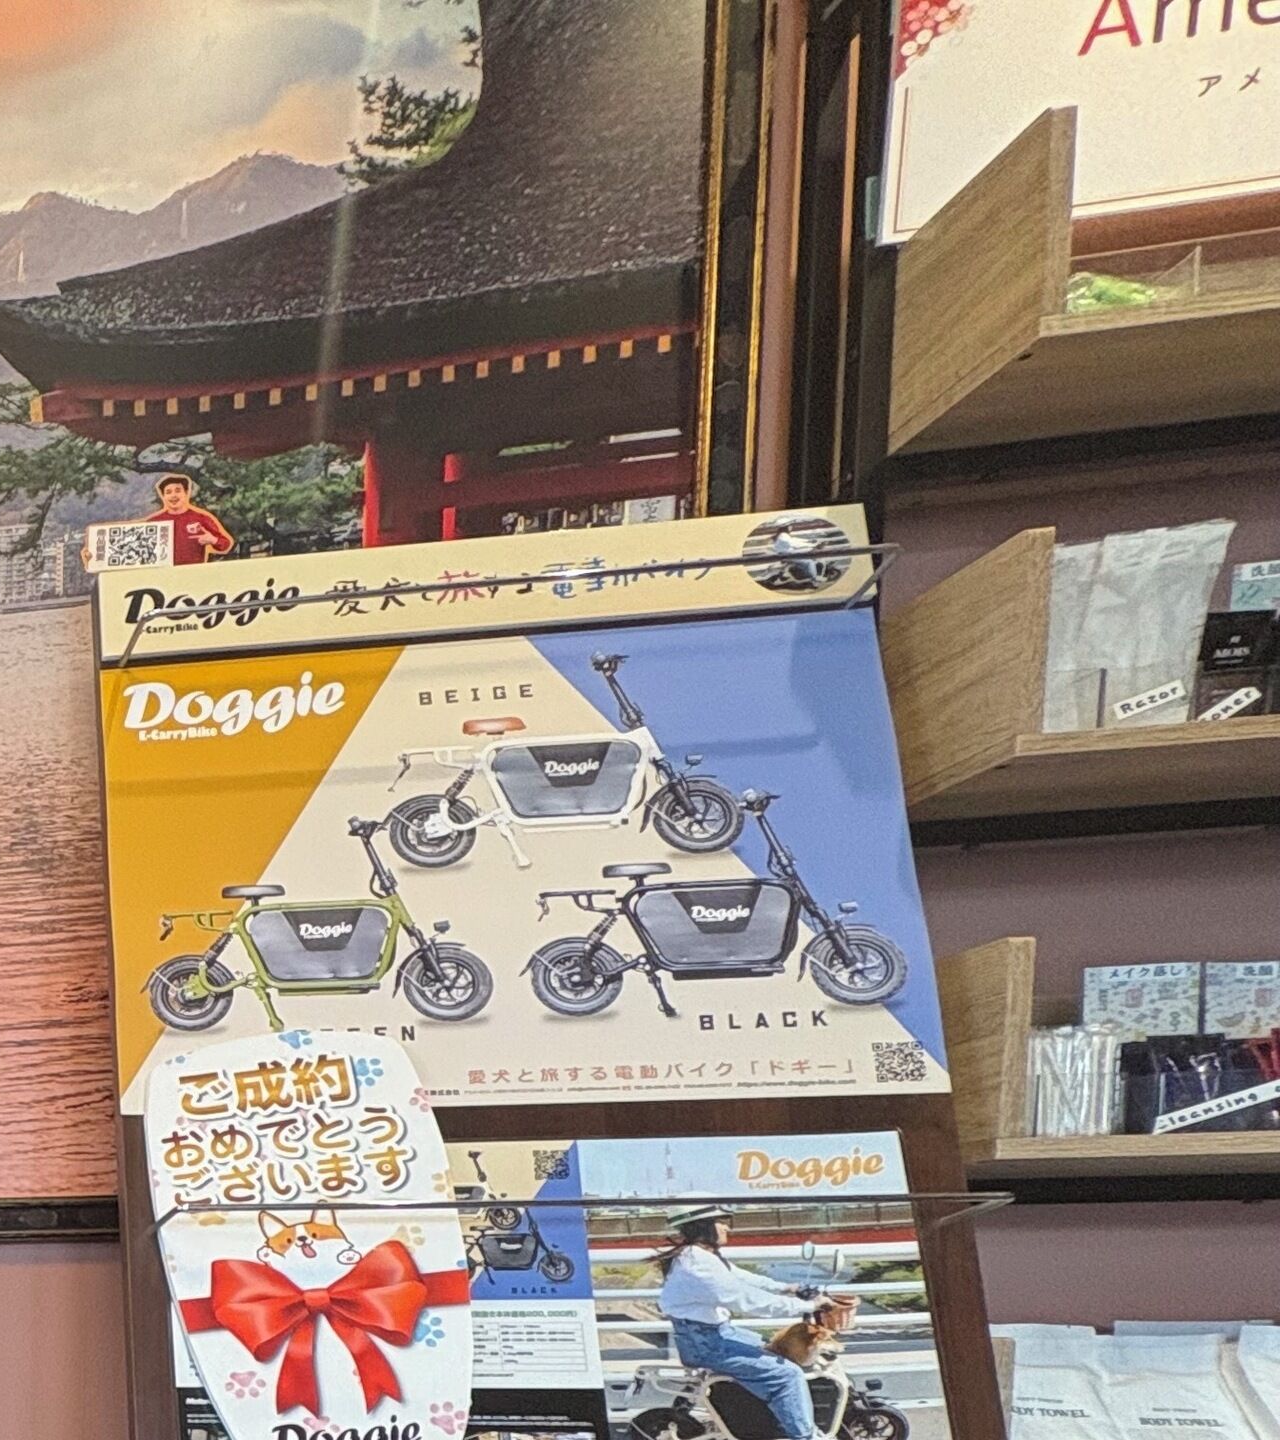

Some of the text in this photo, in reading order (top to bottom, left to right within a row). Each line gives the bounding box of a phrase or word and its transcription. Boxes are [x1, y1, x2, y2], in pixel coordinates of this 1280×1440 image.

[124, 577, 301, 628] Doggie
[141, 623, 199, 634] -CarryBike
[123, 671, 345, 734] Doggie
[418, 684, 534, 706] BEIGE
[1120, 685, 1180, 714] Razor
[139, 725, 218, 741] E-CarryBike
[544, 757, 600, 776] Doggie
[691, 903, 751, 922] Doggie
[299, 920, 354, 939] Doggie
[699, 1010, 828, 1031] BLACK
[178, 1053, 352, 1115] ご成約
[468, 1059, 857, 1084] 愛犬と旅する電動バイク「ドギー」
[161, 1106, 400, 1168] おめでとう
[173, 1147, 408, 1206] ございます
[737, 1147, 884, 1187] Doggie
